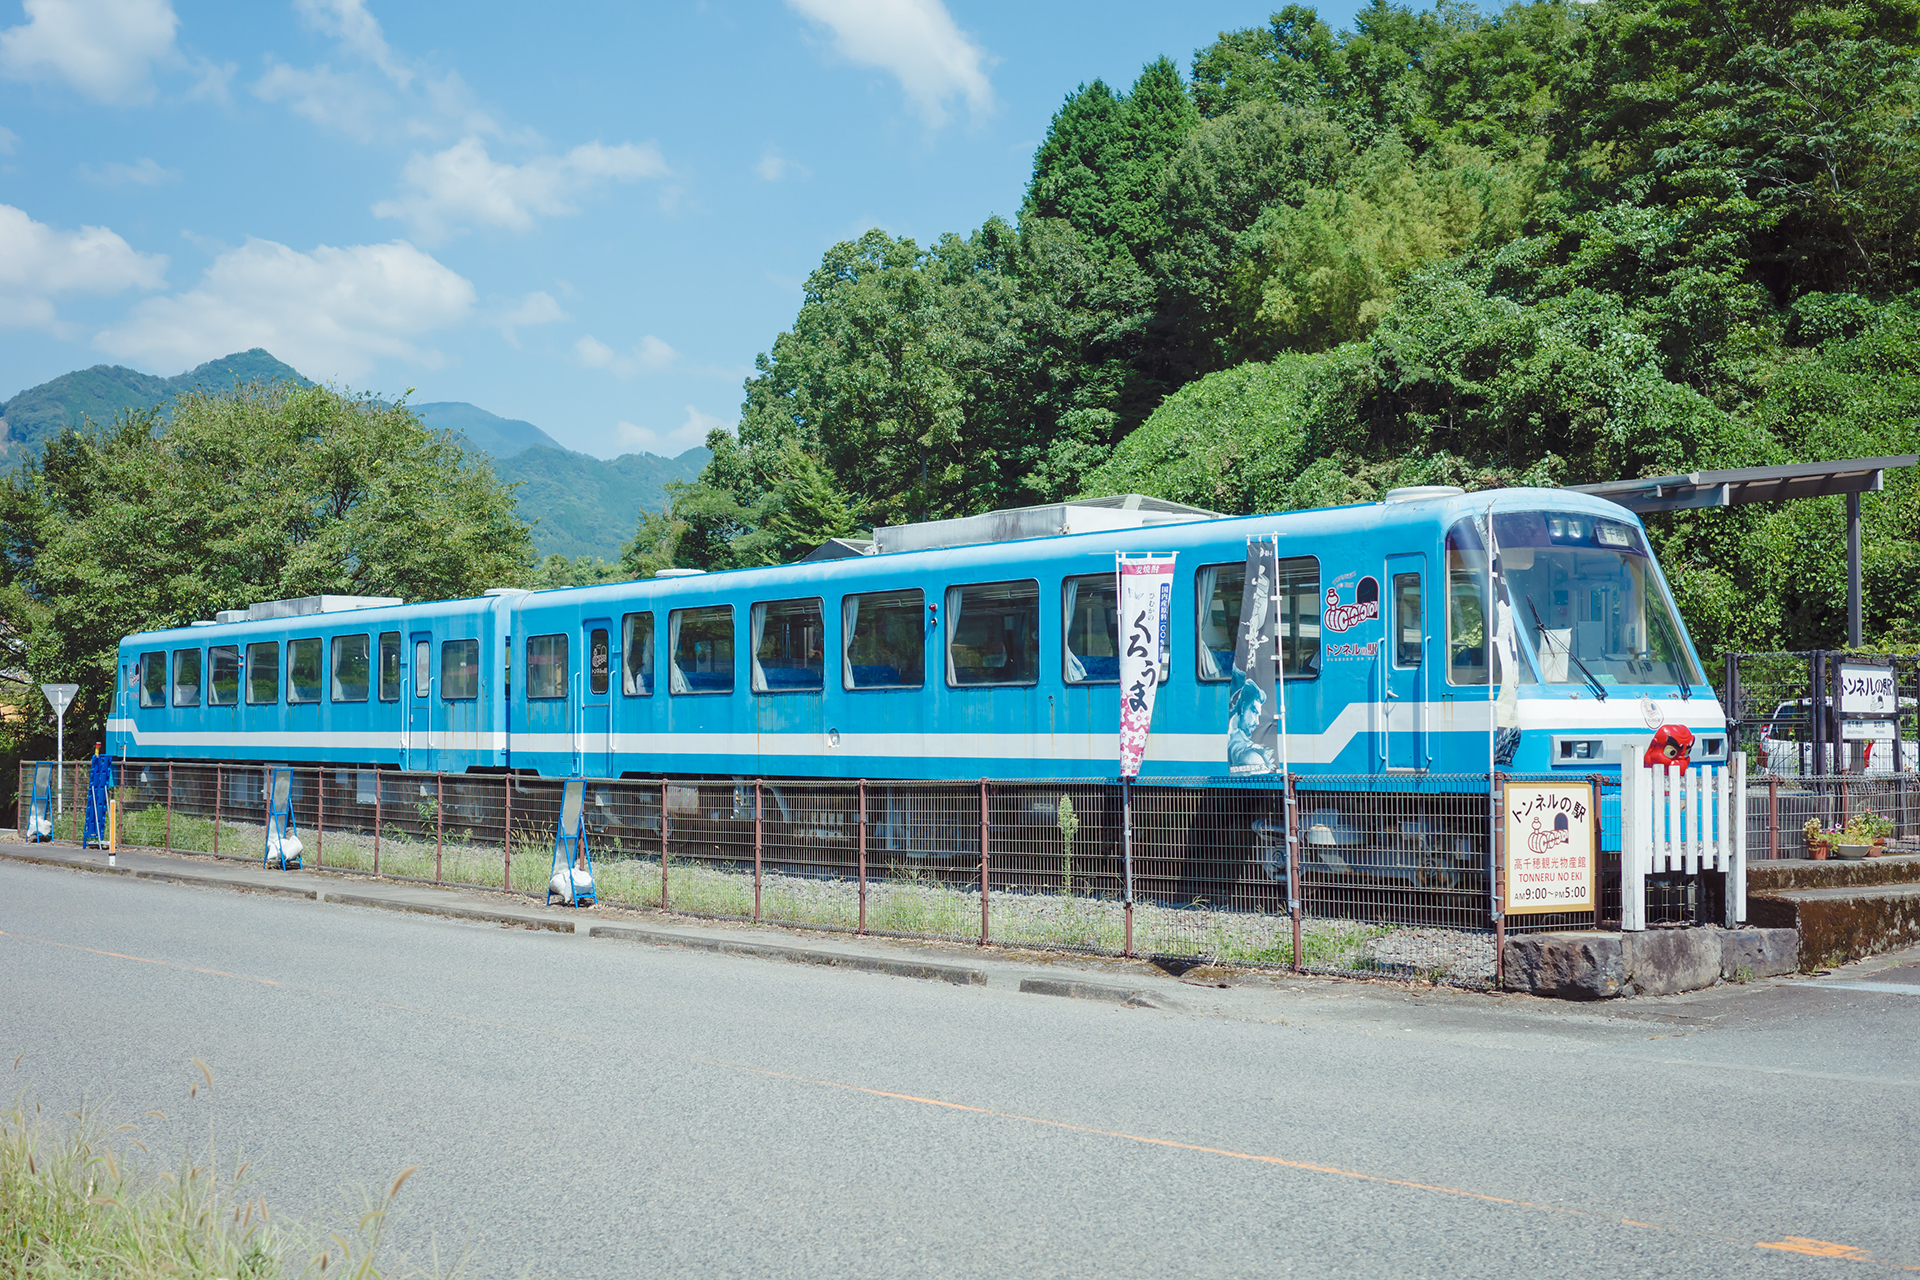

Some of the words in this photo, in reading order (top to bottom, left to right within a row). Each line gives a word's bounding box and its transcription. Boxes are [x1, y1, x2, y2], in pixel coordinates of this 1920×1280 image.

[1135, 564, 1160, 574] 麦焼酎
[1326, 642, 1378, 657] トンネルの駅
[1126, 610, 1157, 712] くろうま
[1841, 677, 1893, 697] トンネルの駅
[1512, 793, 1587, 824] トンネルの駅
[1514, 856, 1586, 870] 高千穂観光物産館
[1519, 873, 1555, 882] TONNERU
[1558, 872, 1569, 881] NO
[1571, 872, 1582, 881] EKI
